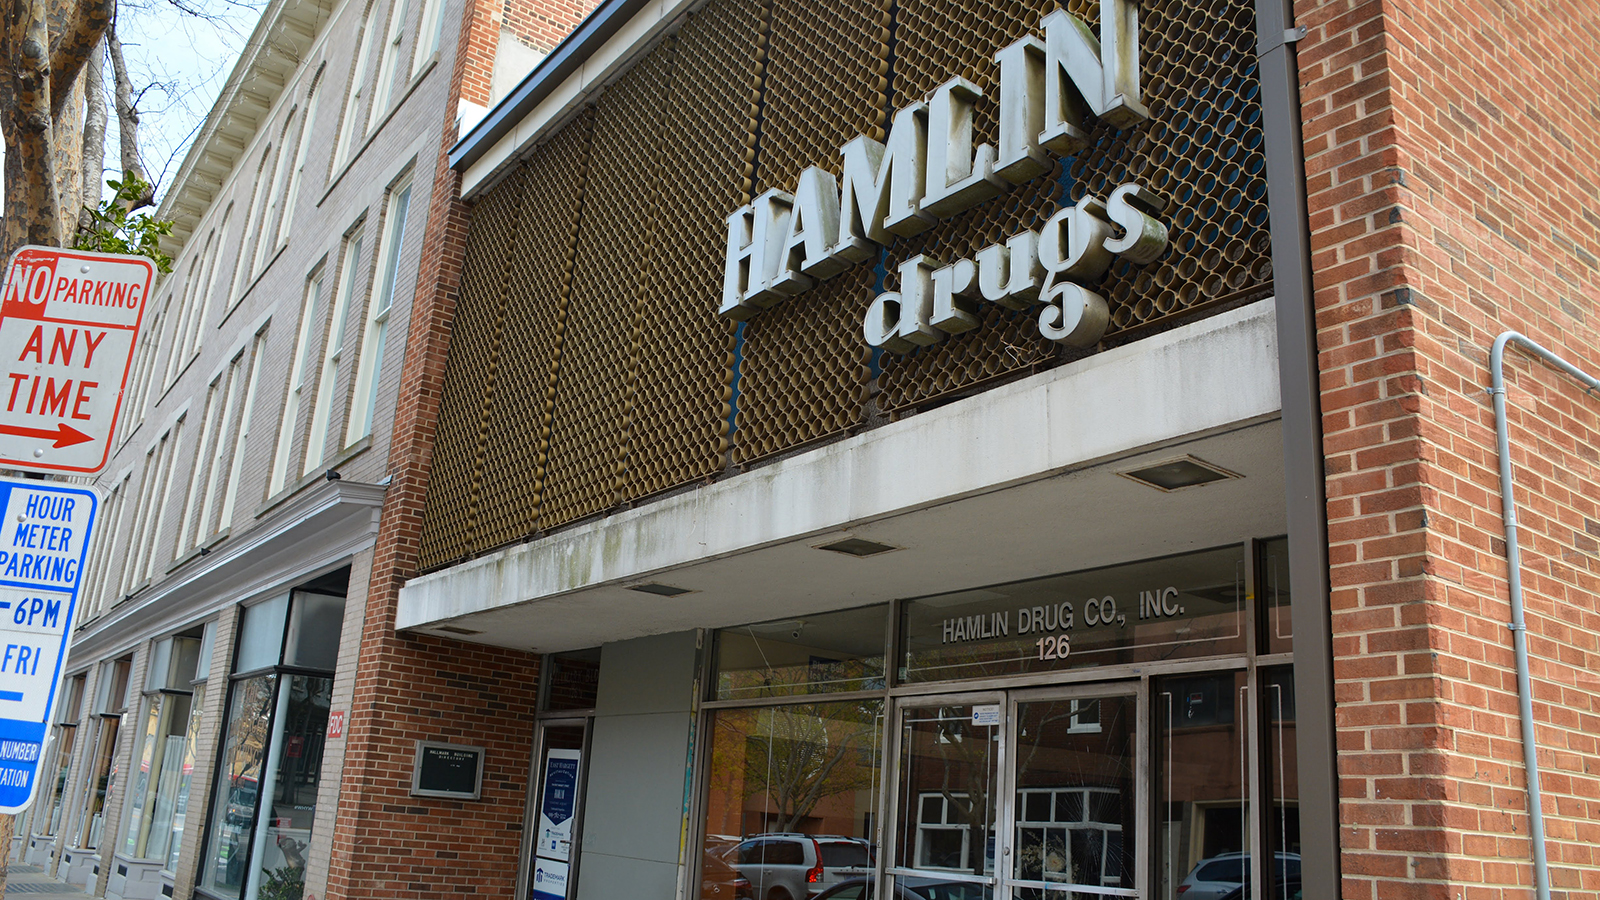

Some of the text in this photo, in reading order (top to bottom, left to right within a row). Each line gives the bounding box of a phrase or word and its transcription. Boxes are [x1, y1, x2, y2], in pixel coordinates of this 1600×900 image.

[717, 0, 1149, 322] HAMLIN
[864, 182, 1168, 354] drugs
[7, 263, 141, 310] NO PARKING
[18, 324, 108, 369] ANY
[7, 372, 99, 421] TIME
[26, 493, 76, 522] HOUR
[13, 523, 73, 552] METER
[0, 551, 77, 583] PARKING
[941, 586, 1185, 644] HAMLIN DRUG CO., INC.
[1, 643, 42, 676] FRI
[1035, 634, 1071, 661] 126
[329, 714, 343, 734] FDC
[0, 740, 38, 761] NUMBER
